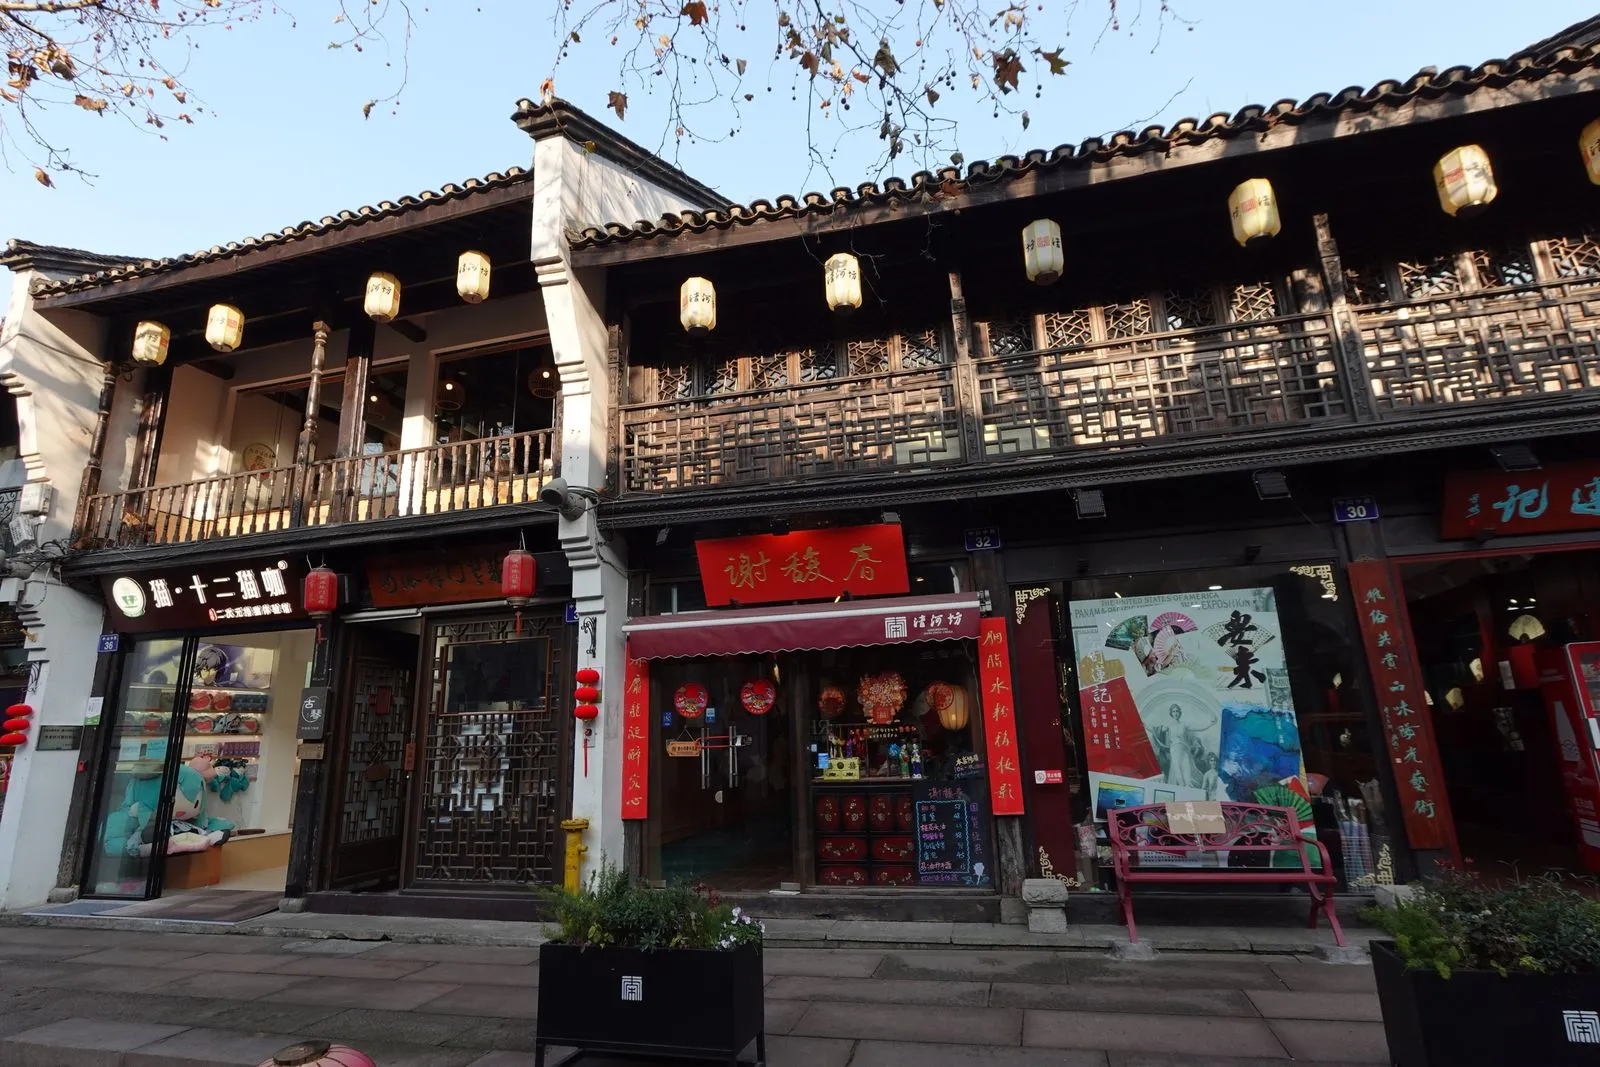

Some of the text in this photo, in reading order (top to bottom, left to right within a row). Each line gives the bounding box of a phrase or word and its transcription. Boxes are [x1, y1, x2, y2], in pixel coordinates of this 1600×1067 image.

[1346, 505, 1367, 519] 30
[975, 536, 991, 547] 32
[913, 611, 963, 628] 清河坊
[104, 641, 114, 650] 36
